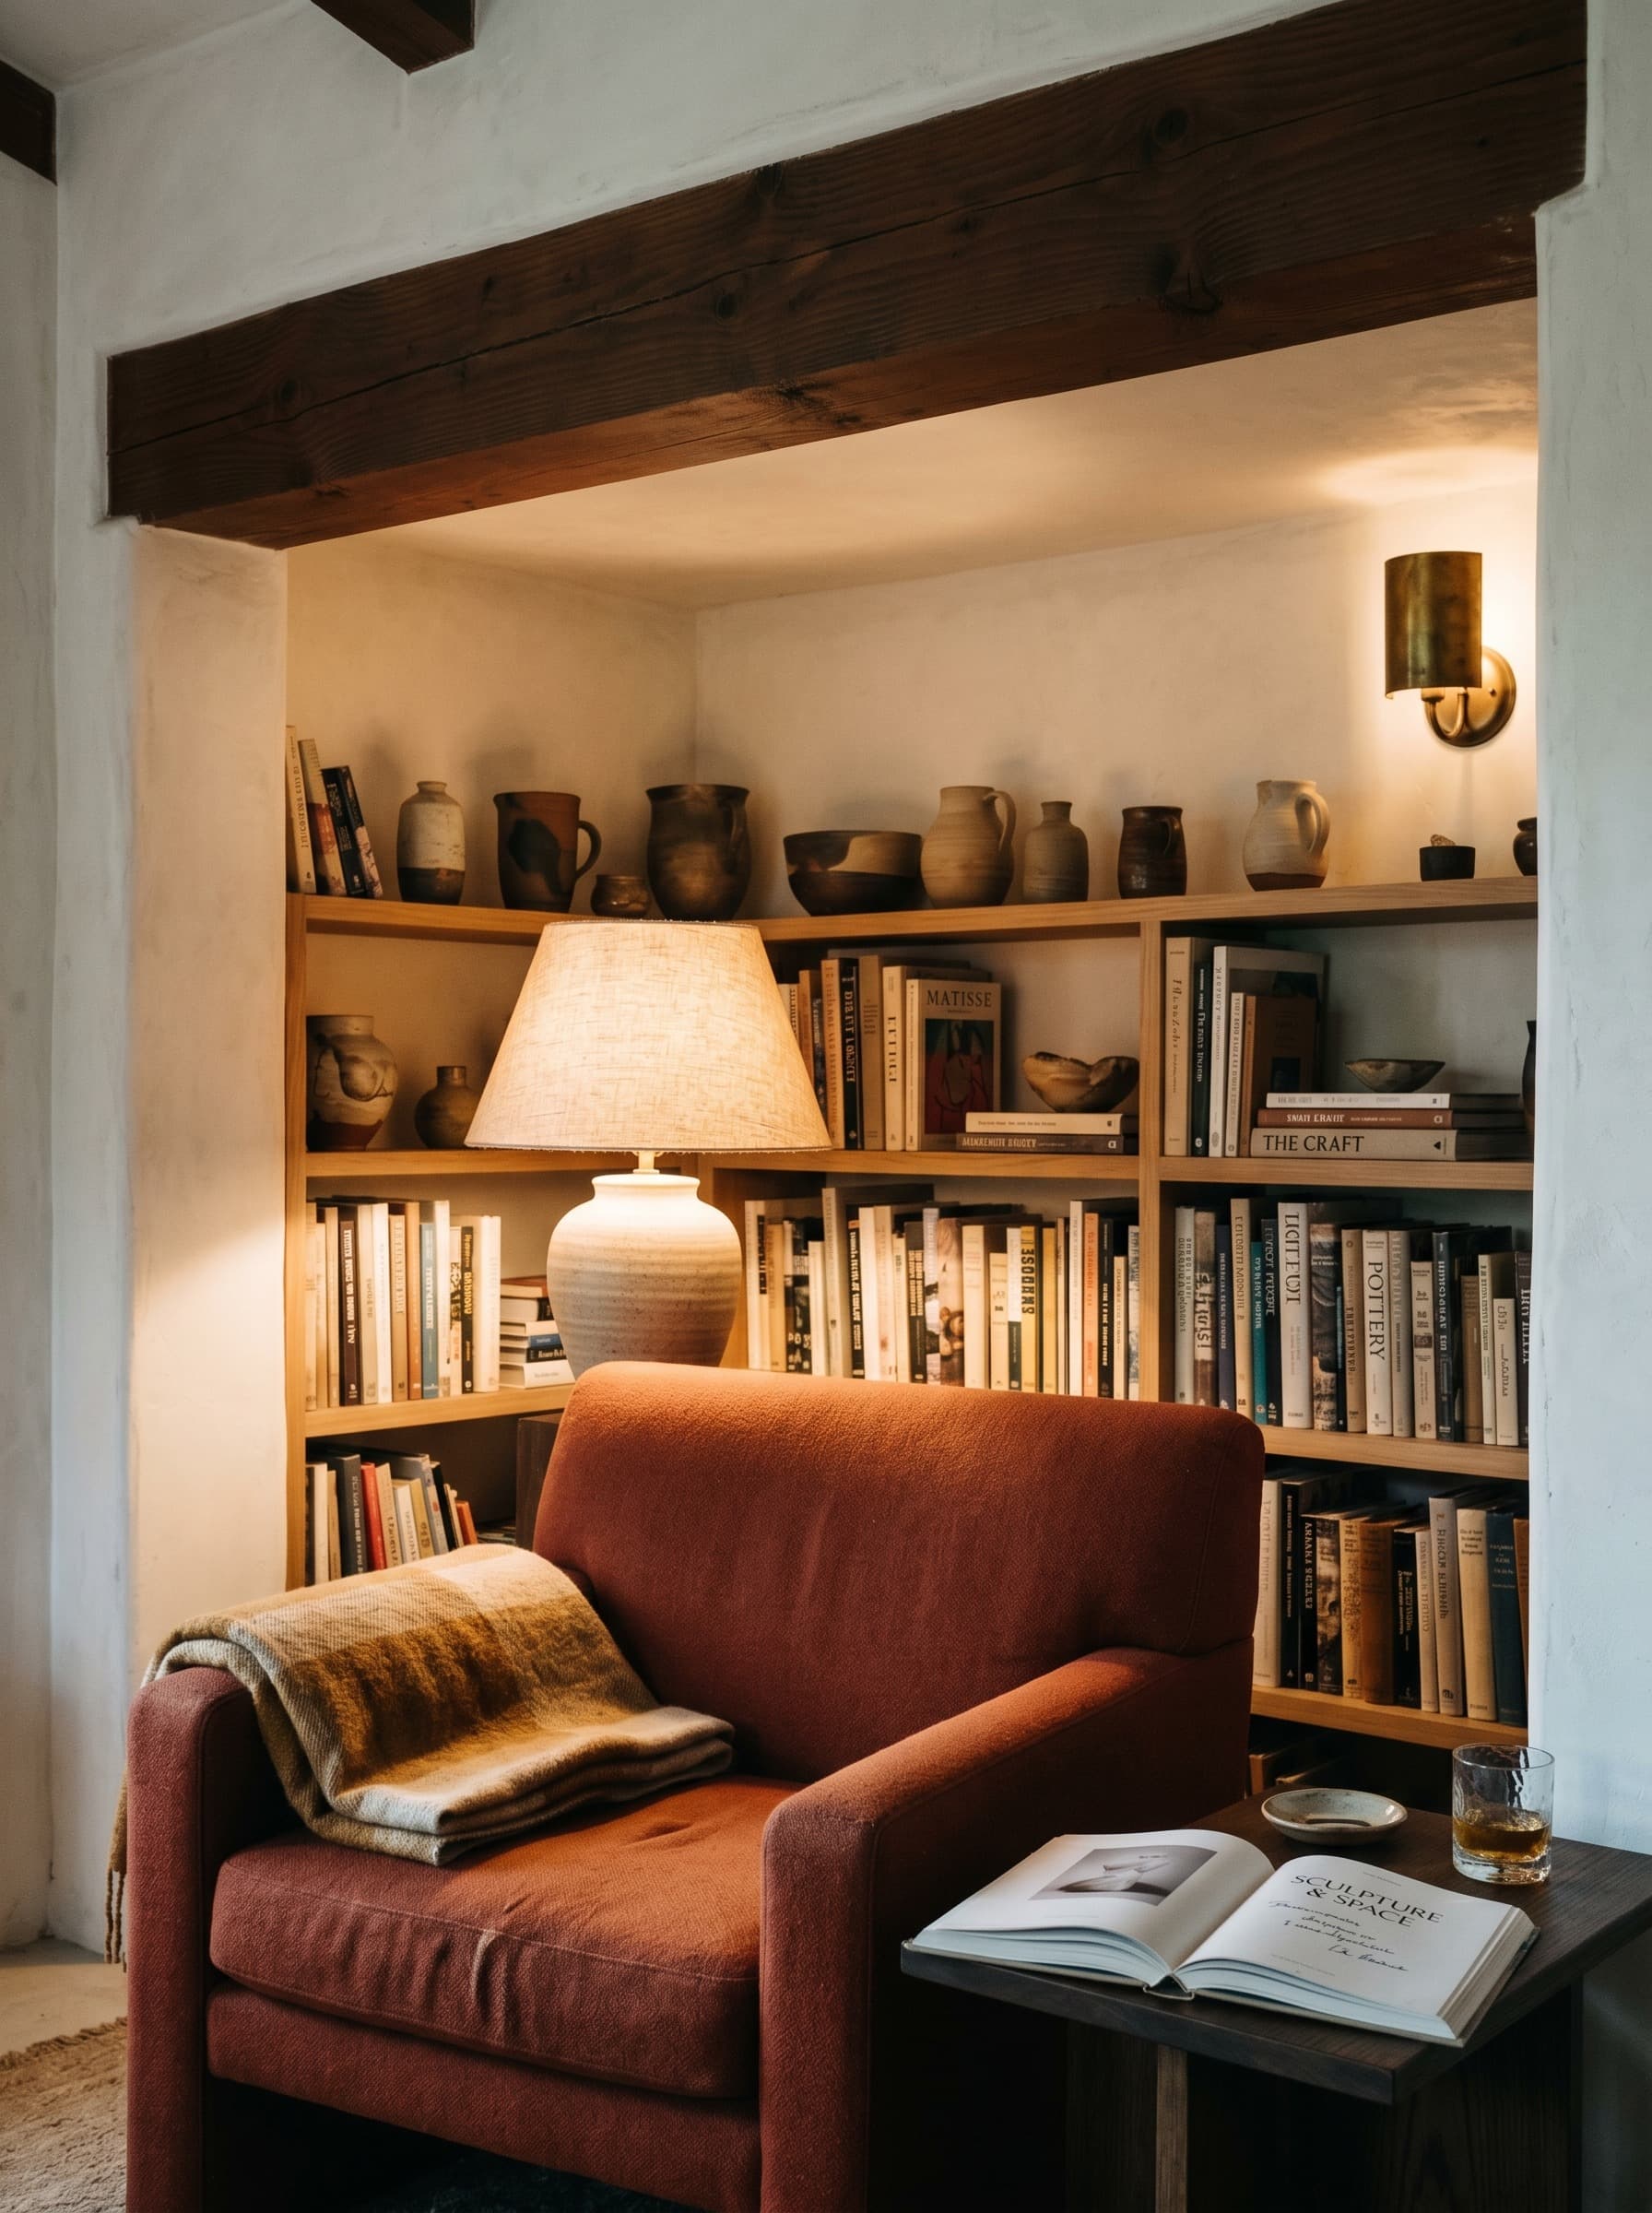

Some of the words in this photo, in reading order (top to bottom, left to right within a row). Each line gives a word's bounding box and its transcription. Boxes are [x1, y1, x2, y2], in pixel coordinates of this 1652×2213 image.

[926, 989, 992, 1007] MATISSE
[1263, 1135, 1298, 1151] THE
[1304, 1135, 1364, 1152] CRAFT
[1368, 1261, 1385, 1360] POTTERY
[1291, 1875, 1445, 1923] SCULPTURE
[1306, 1888, 1328, 1898] &
[1333, 1894, 1416, 1927] SPACE
